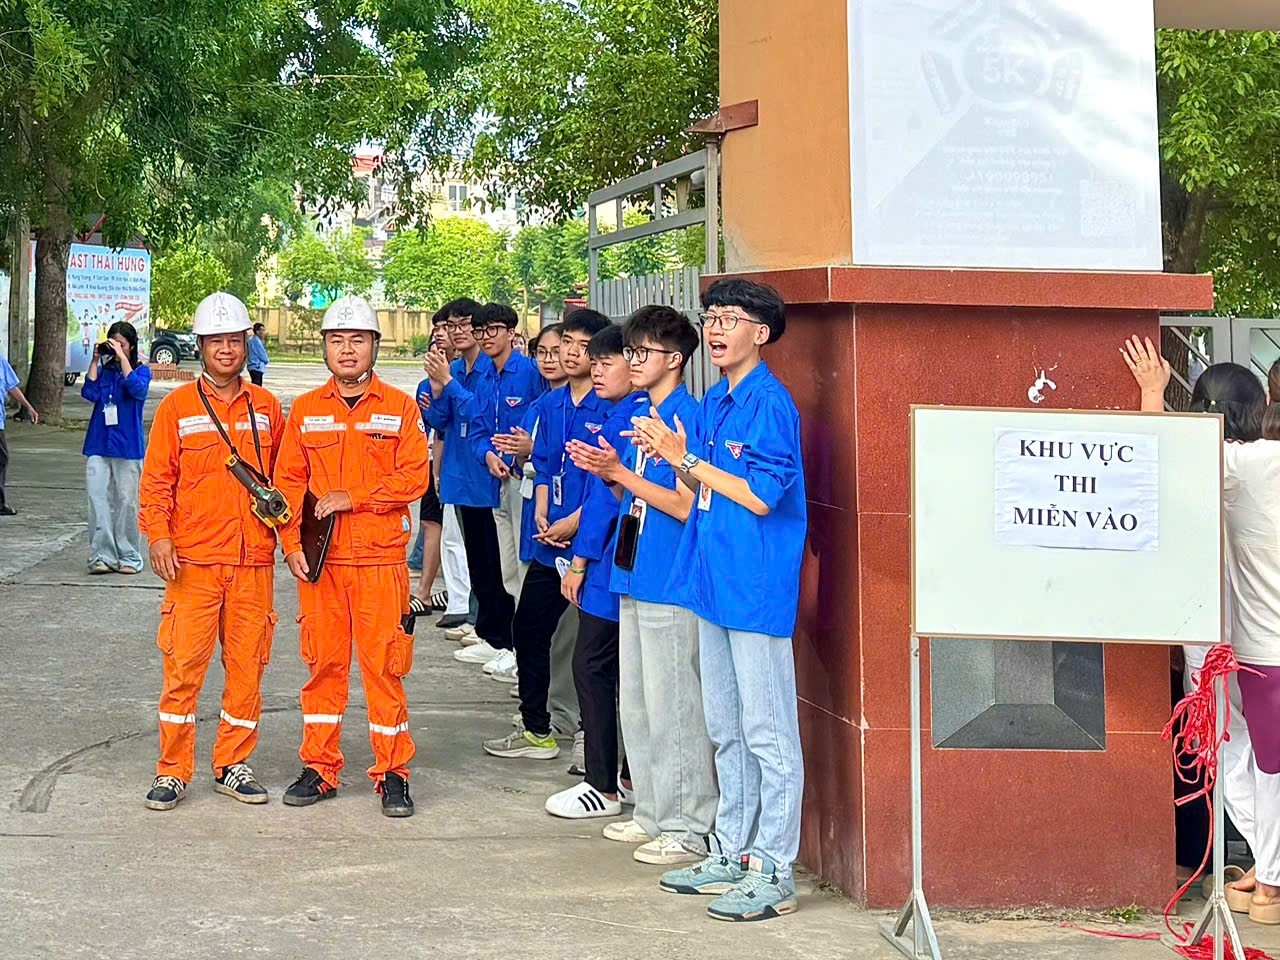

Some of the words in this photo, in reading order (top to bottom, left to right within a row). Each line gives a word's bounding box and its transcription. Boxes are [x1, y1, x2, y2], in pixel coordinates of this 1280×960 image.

[1019, 438, 1074, 460] KHU
[1080, 441, 1135, 467] VỰC
[1054, 473, 1098, 495] THI
[1012, 503, 1079, 528] MIỄN
[1084, 506, 1139, 532] VÀO
